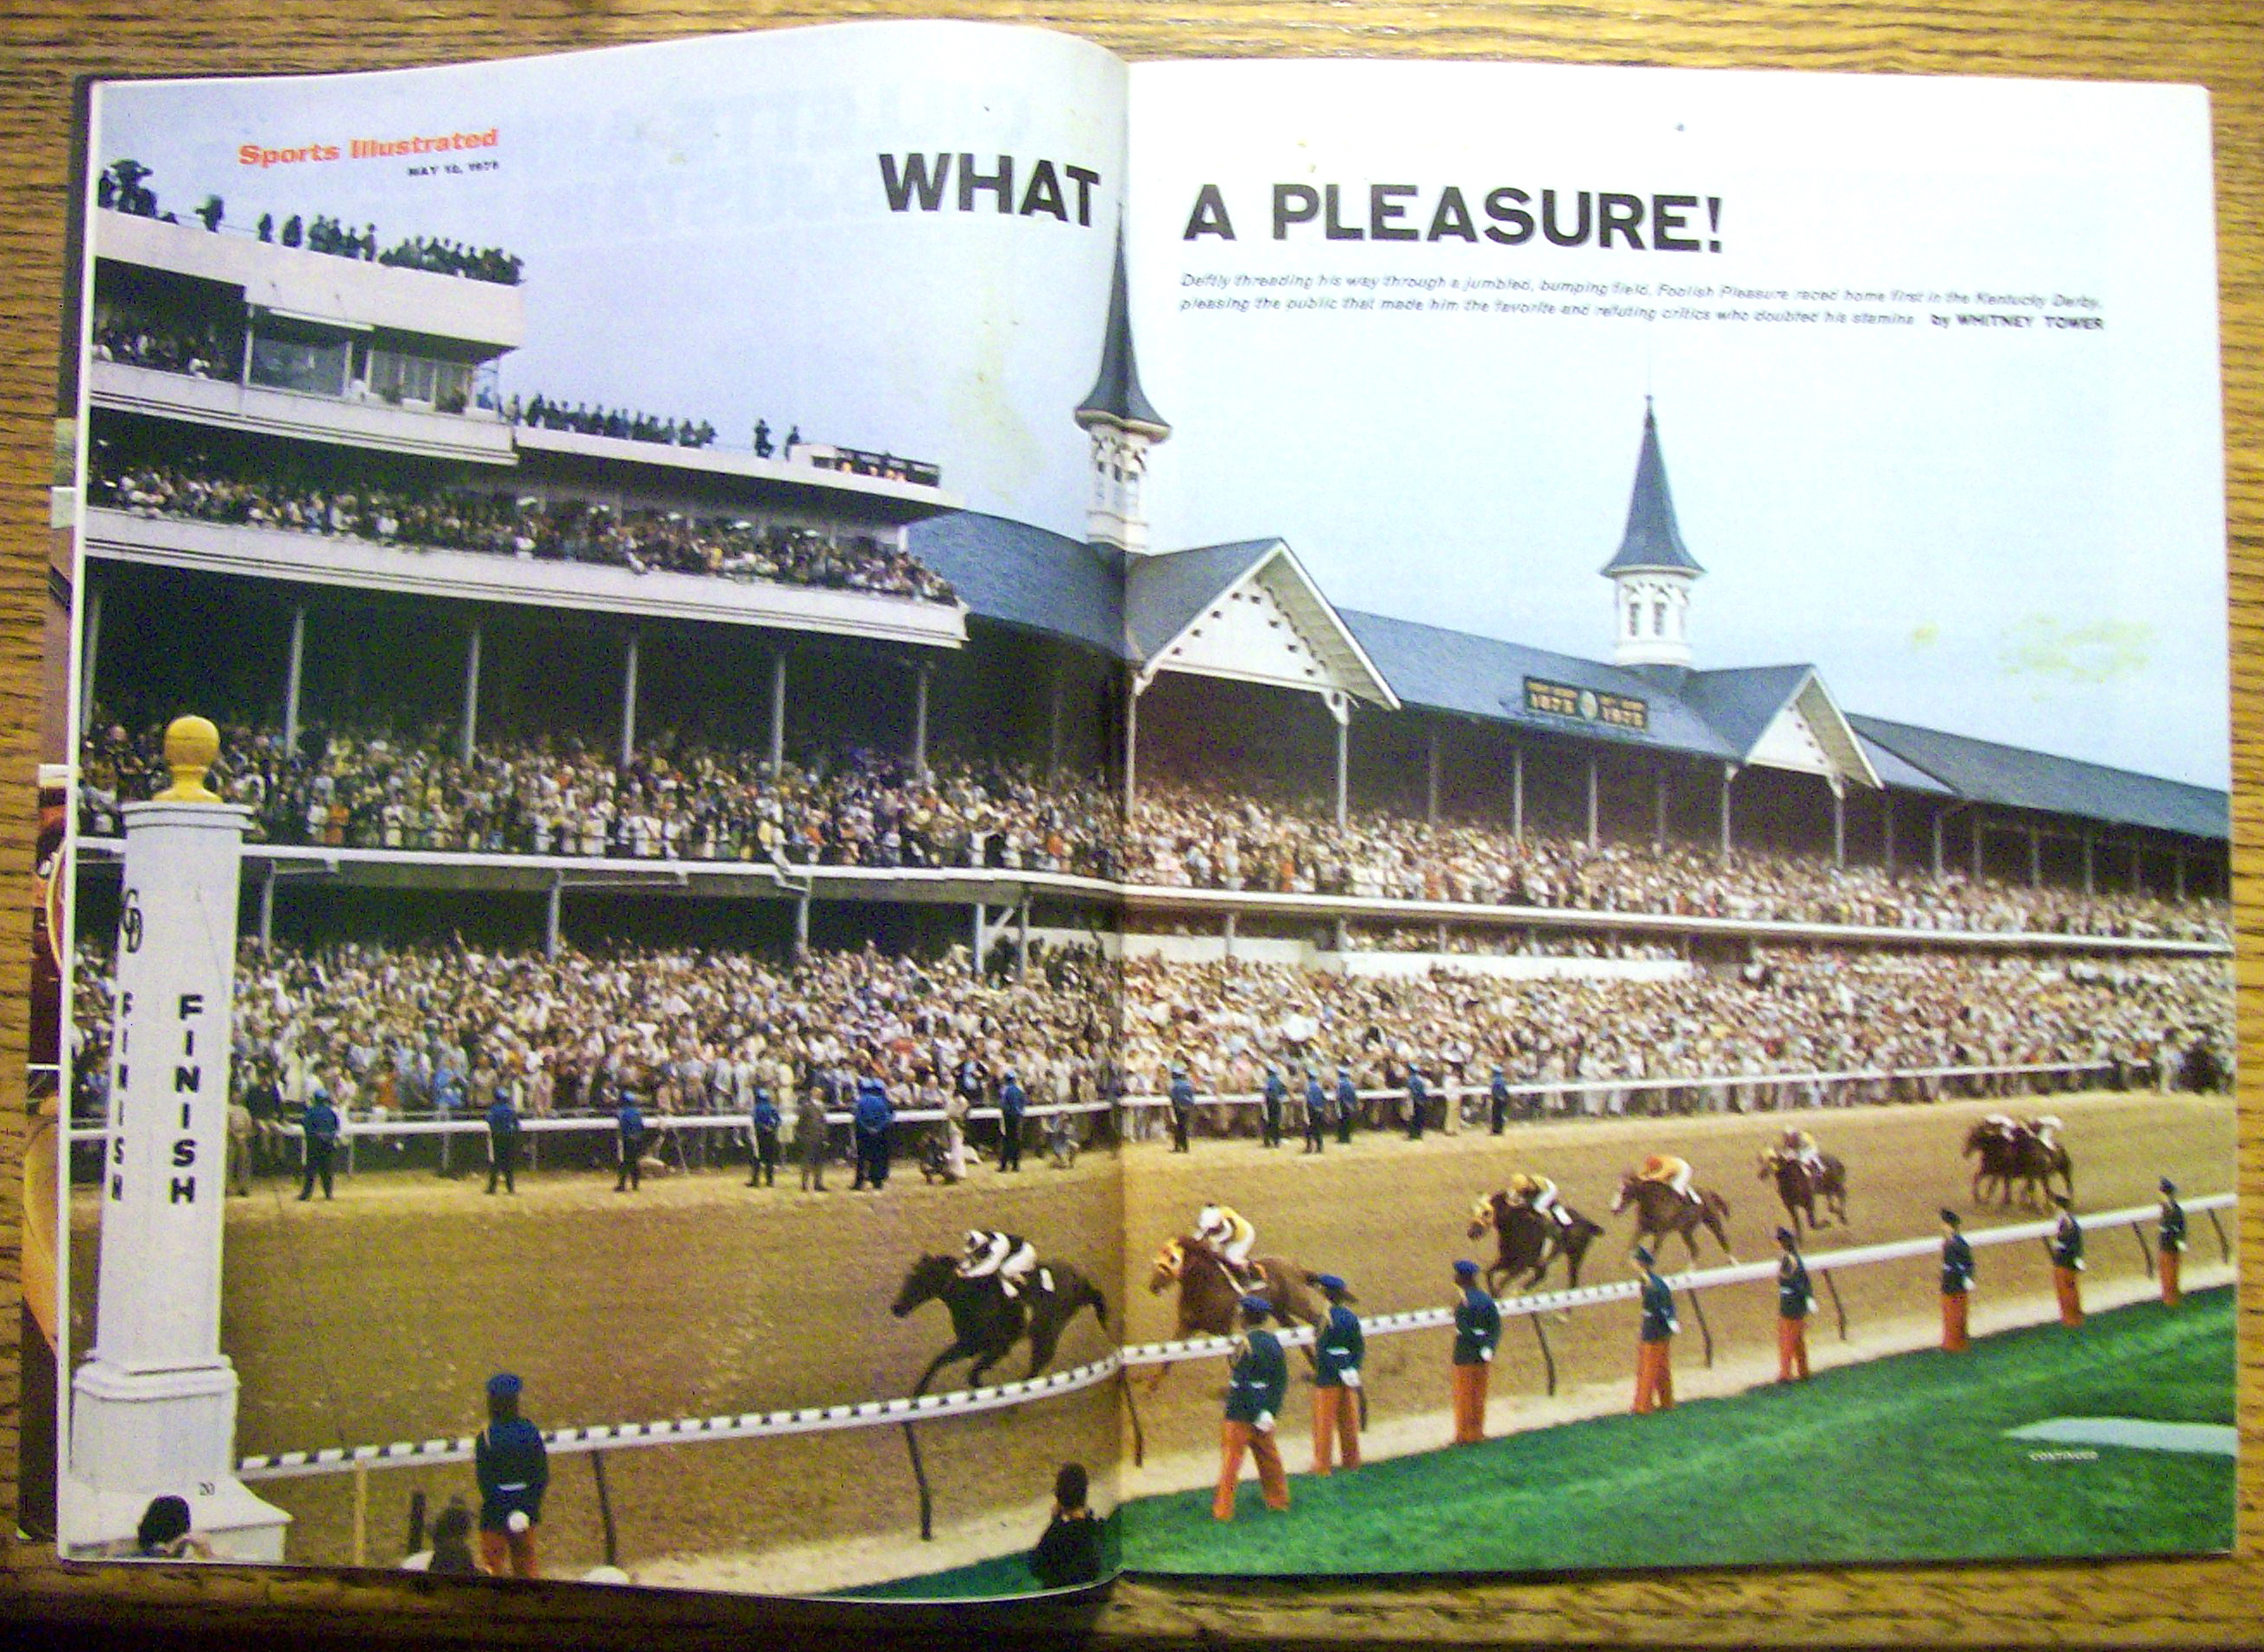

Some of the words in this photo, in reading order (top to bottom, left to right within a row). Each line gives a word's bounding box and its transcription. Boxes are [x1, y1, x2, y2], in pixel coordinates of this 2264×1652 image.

[239, 141, 340, 168] Sports
[349, 126, 499, 159] Illustrated
[407, 165, 438, 177] MAY
[879, 152, 1099, 226] WHAT
[1183, 184, 1236, 242] A
[1272, 183, 1723, 253] PLEASURE!
[1955, 313, 2034, 328] WHITNEY
[2043, 315, 2106, 330] TOWER
[170, 993, 204, 1206] FINISH
